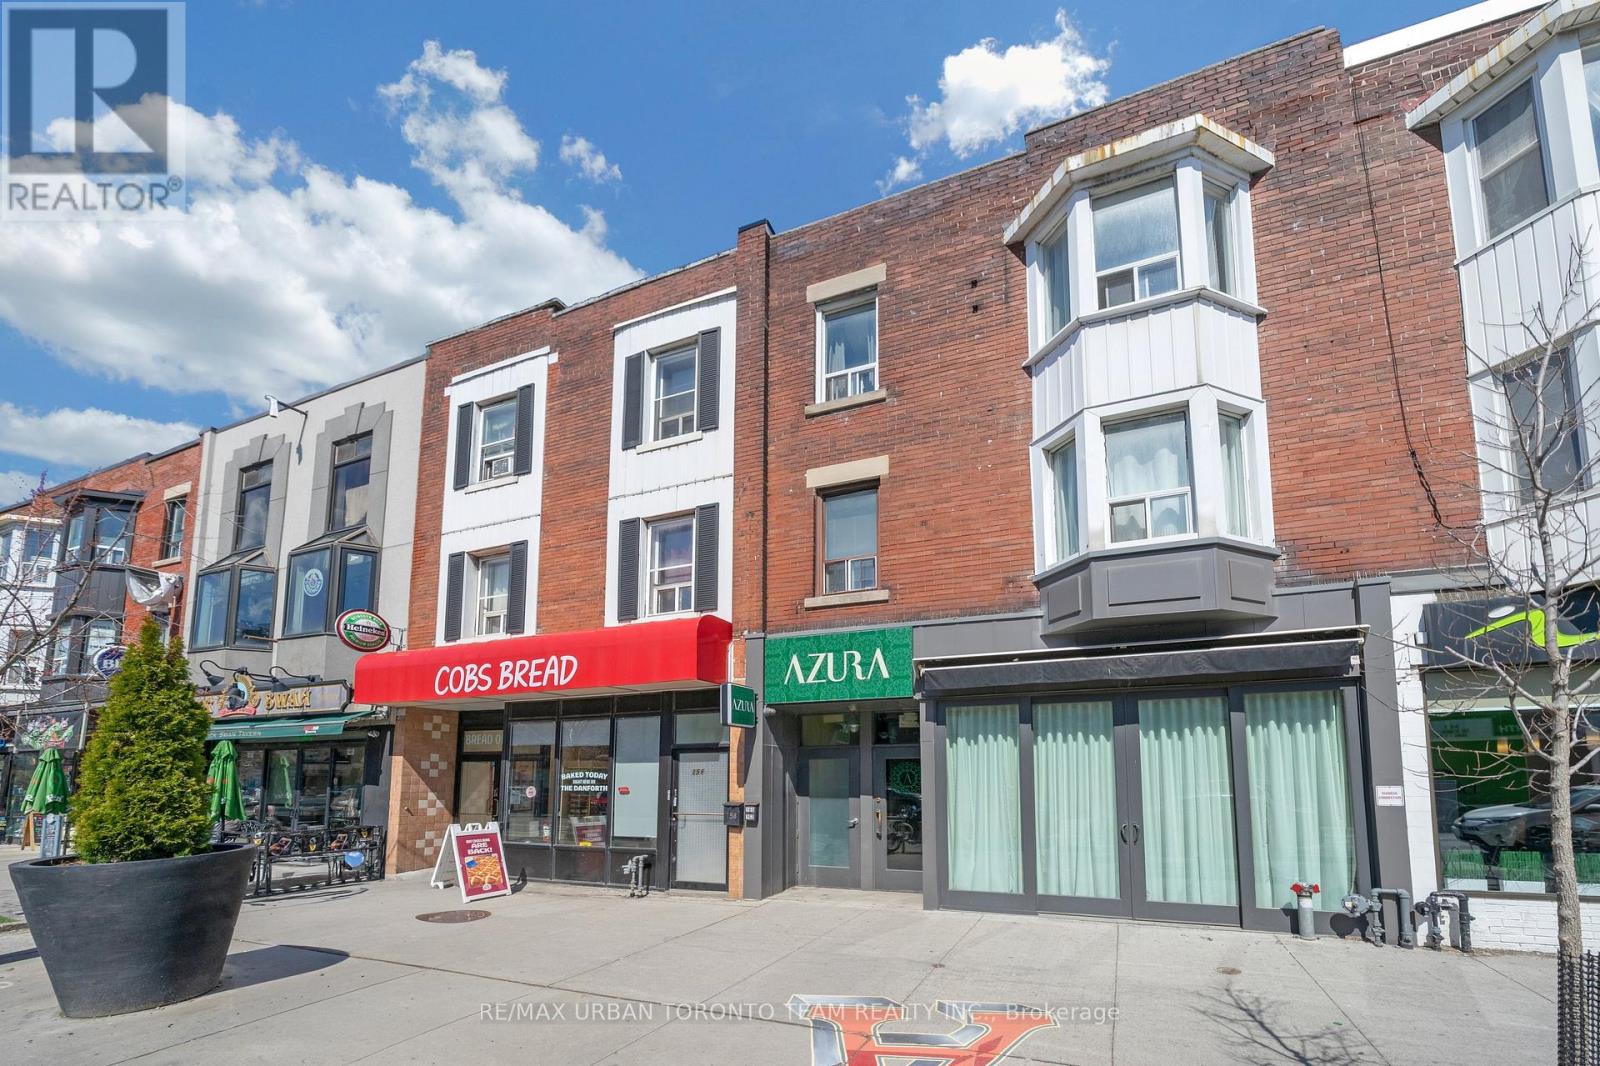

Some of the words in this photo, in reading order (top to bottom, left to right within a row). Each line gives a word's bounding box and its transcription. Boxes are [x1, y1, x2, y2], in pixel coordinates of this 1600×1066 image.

[346, 623, 385, 636] Heineken
[783, 647, 890, 685] AZURA
[434, 663, 492, 696] COBS
[497, 655, 578, 691] BREAD
[732, 698, 755, 713] AZURA
[465, 734, 493, 745] BREAD
[561, 771, 584, 780] BAKED
[585, 771, 608, 780] TODAY
